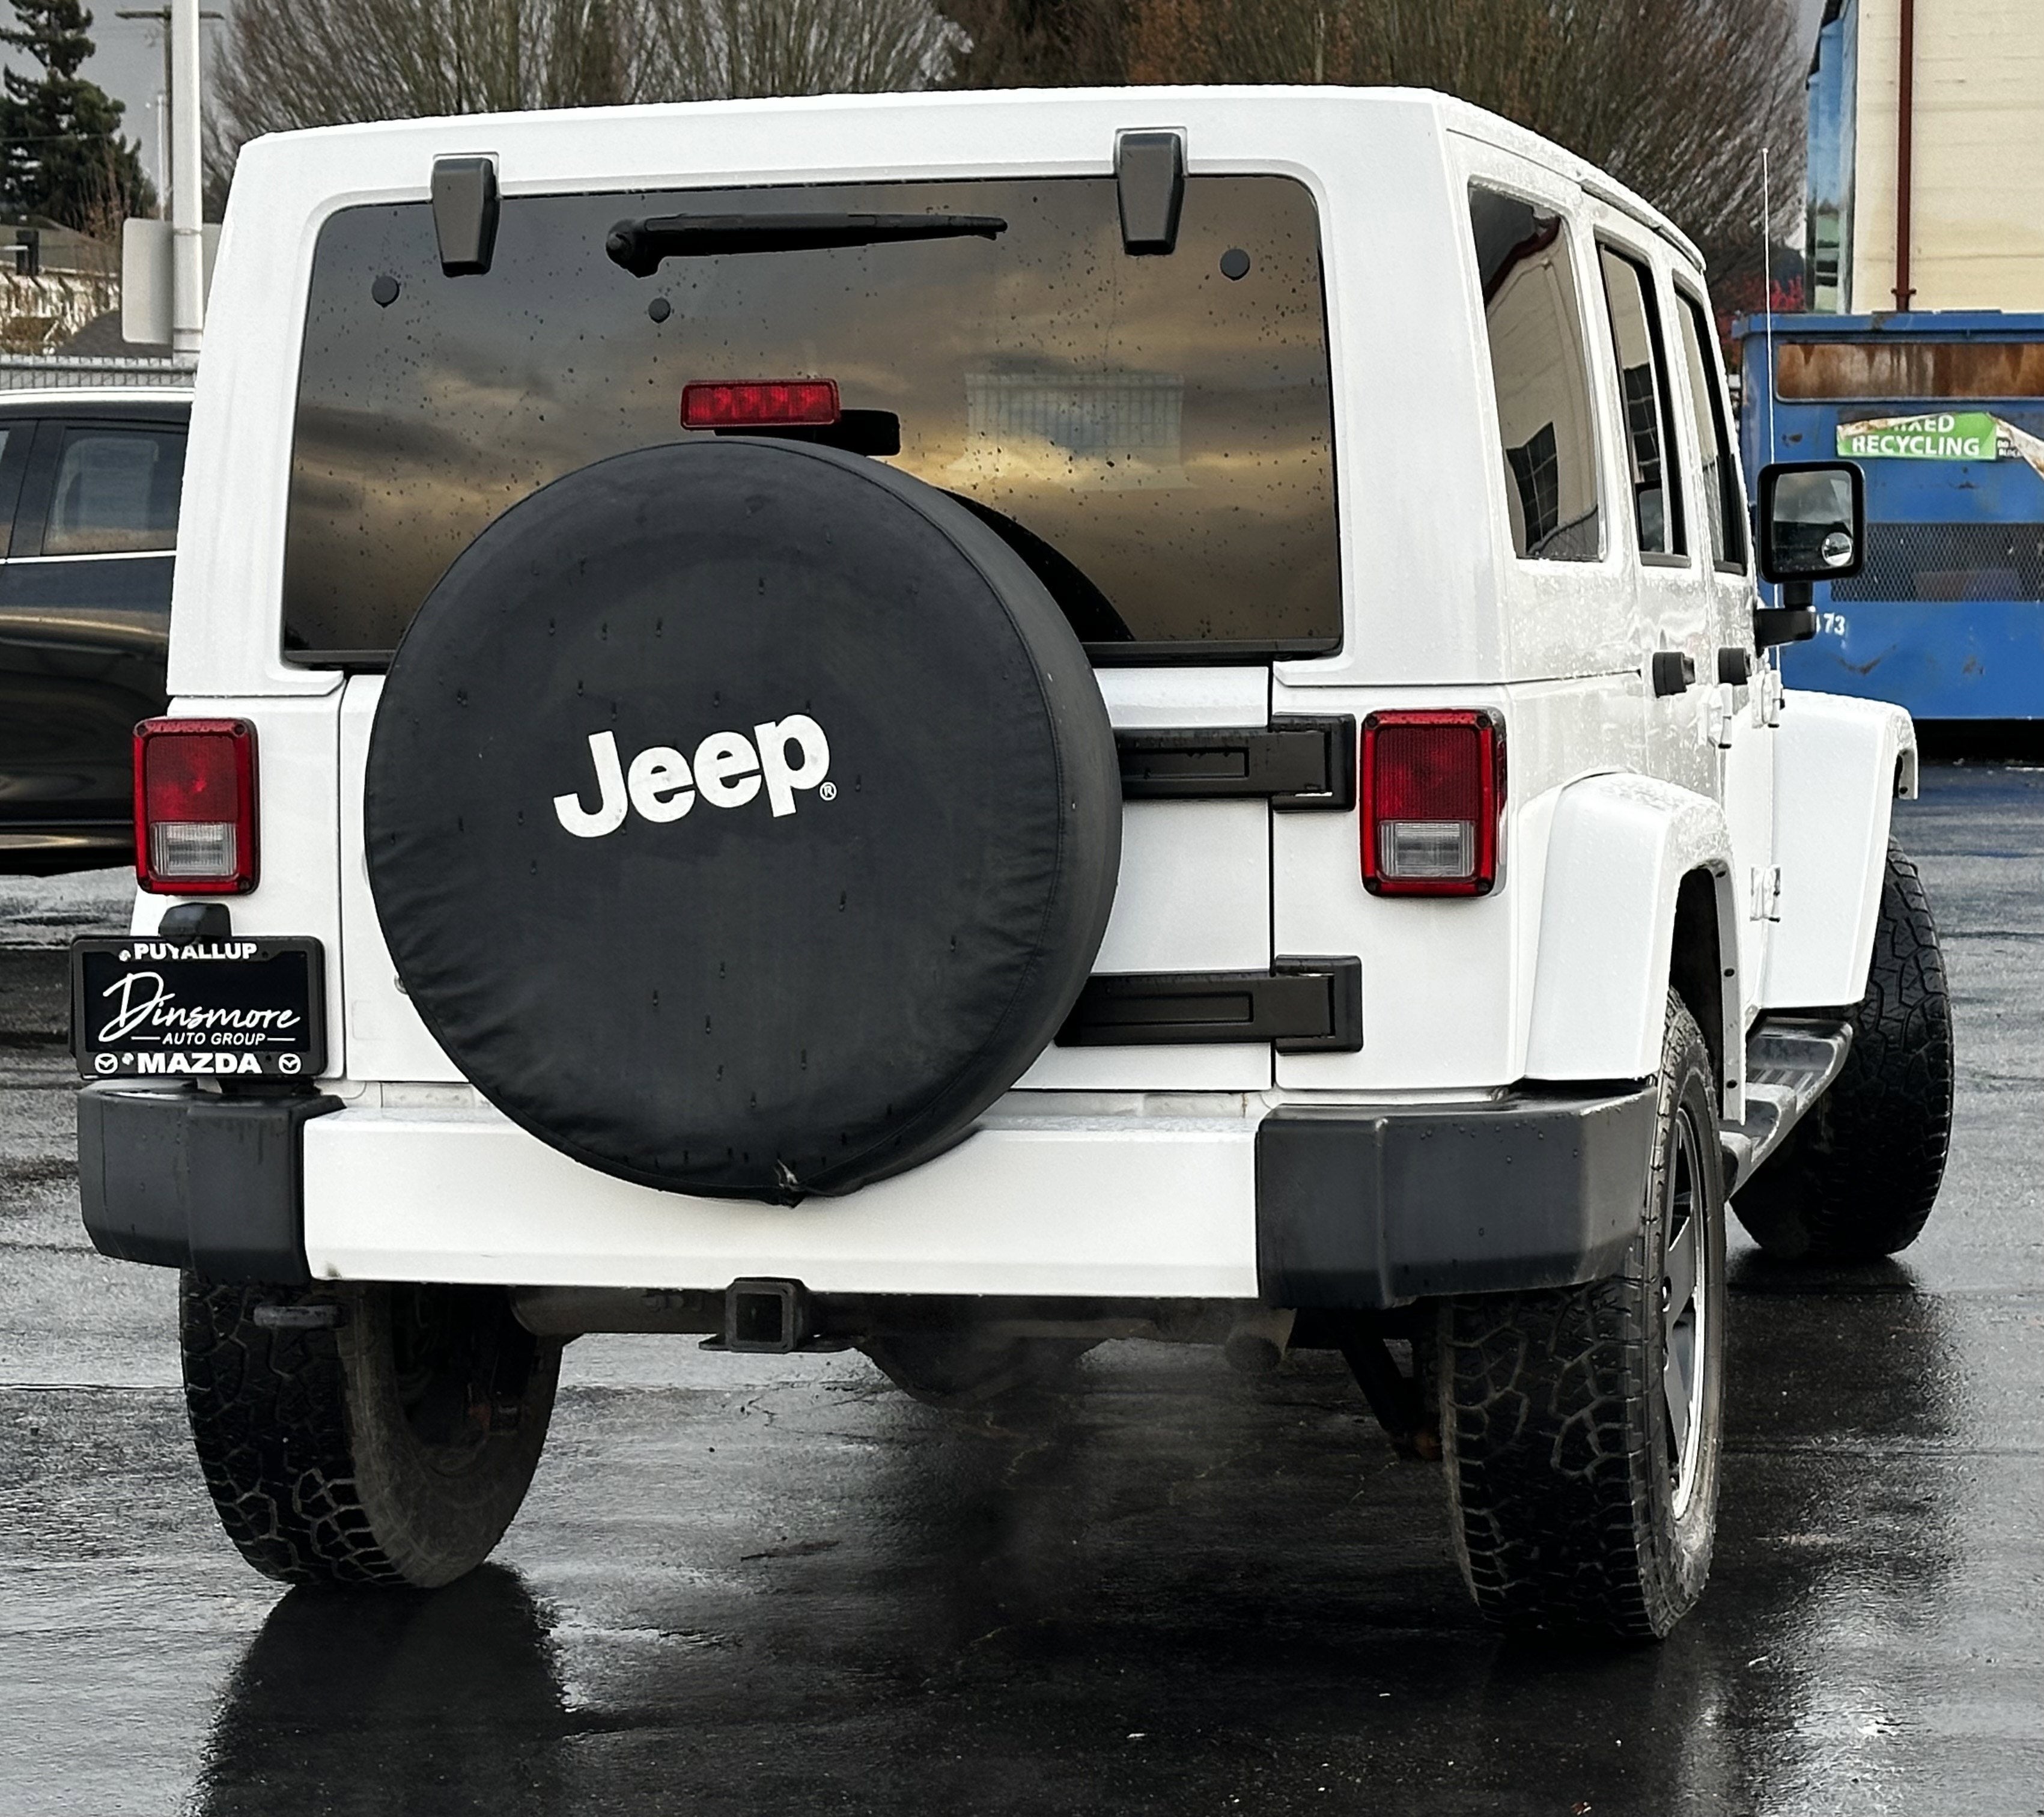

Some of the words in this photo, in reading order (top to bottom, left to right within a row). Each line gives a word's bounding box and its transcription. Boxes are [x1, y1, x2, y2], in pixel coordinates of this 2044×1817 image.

[1893, 415, 1954, 433] XED
[1852, 434, 1979, 456] RECYCLING
[134, 943, 257, 960] PUYALLUP
[99, 972, 300, 1042] Dinsmore
[162, 1033, 205, 1045] AUTO
[211, 1033, 266, 1045] GROUP
[137, 1053, 263, 1074] MAZDA
